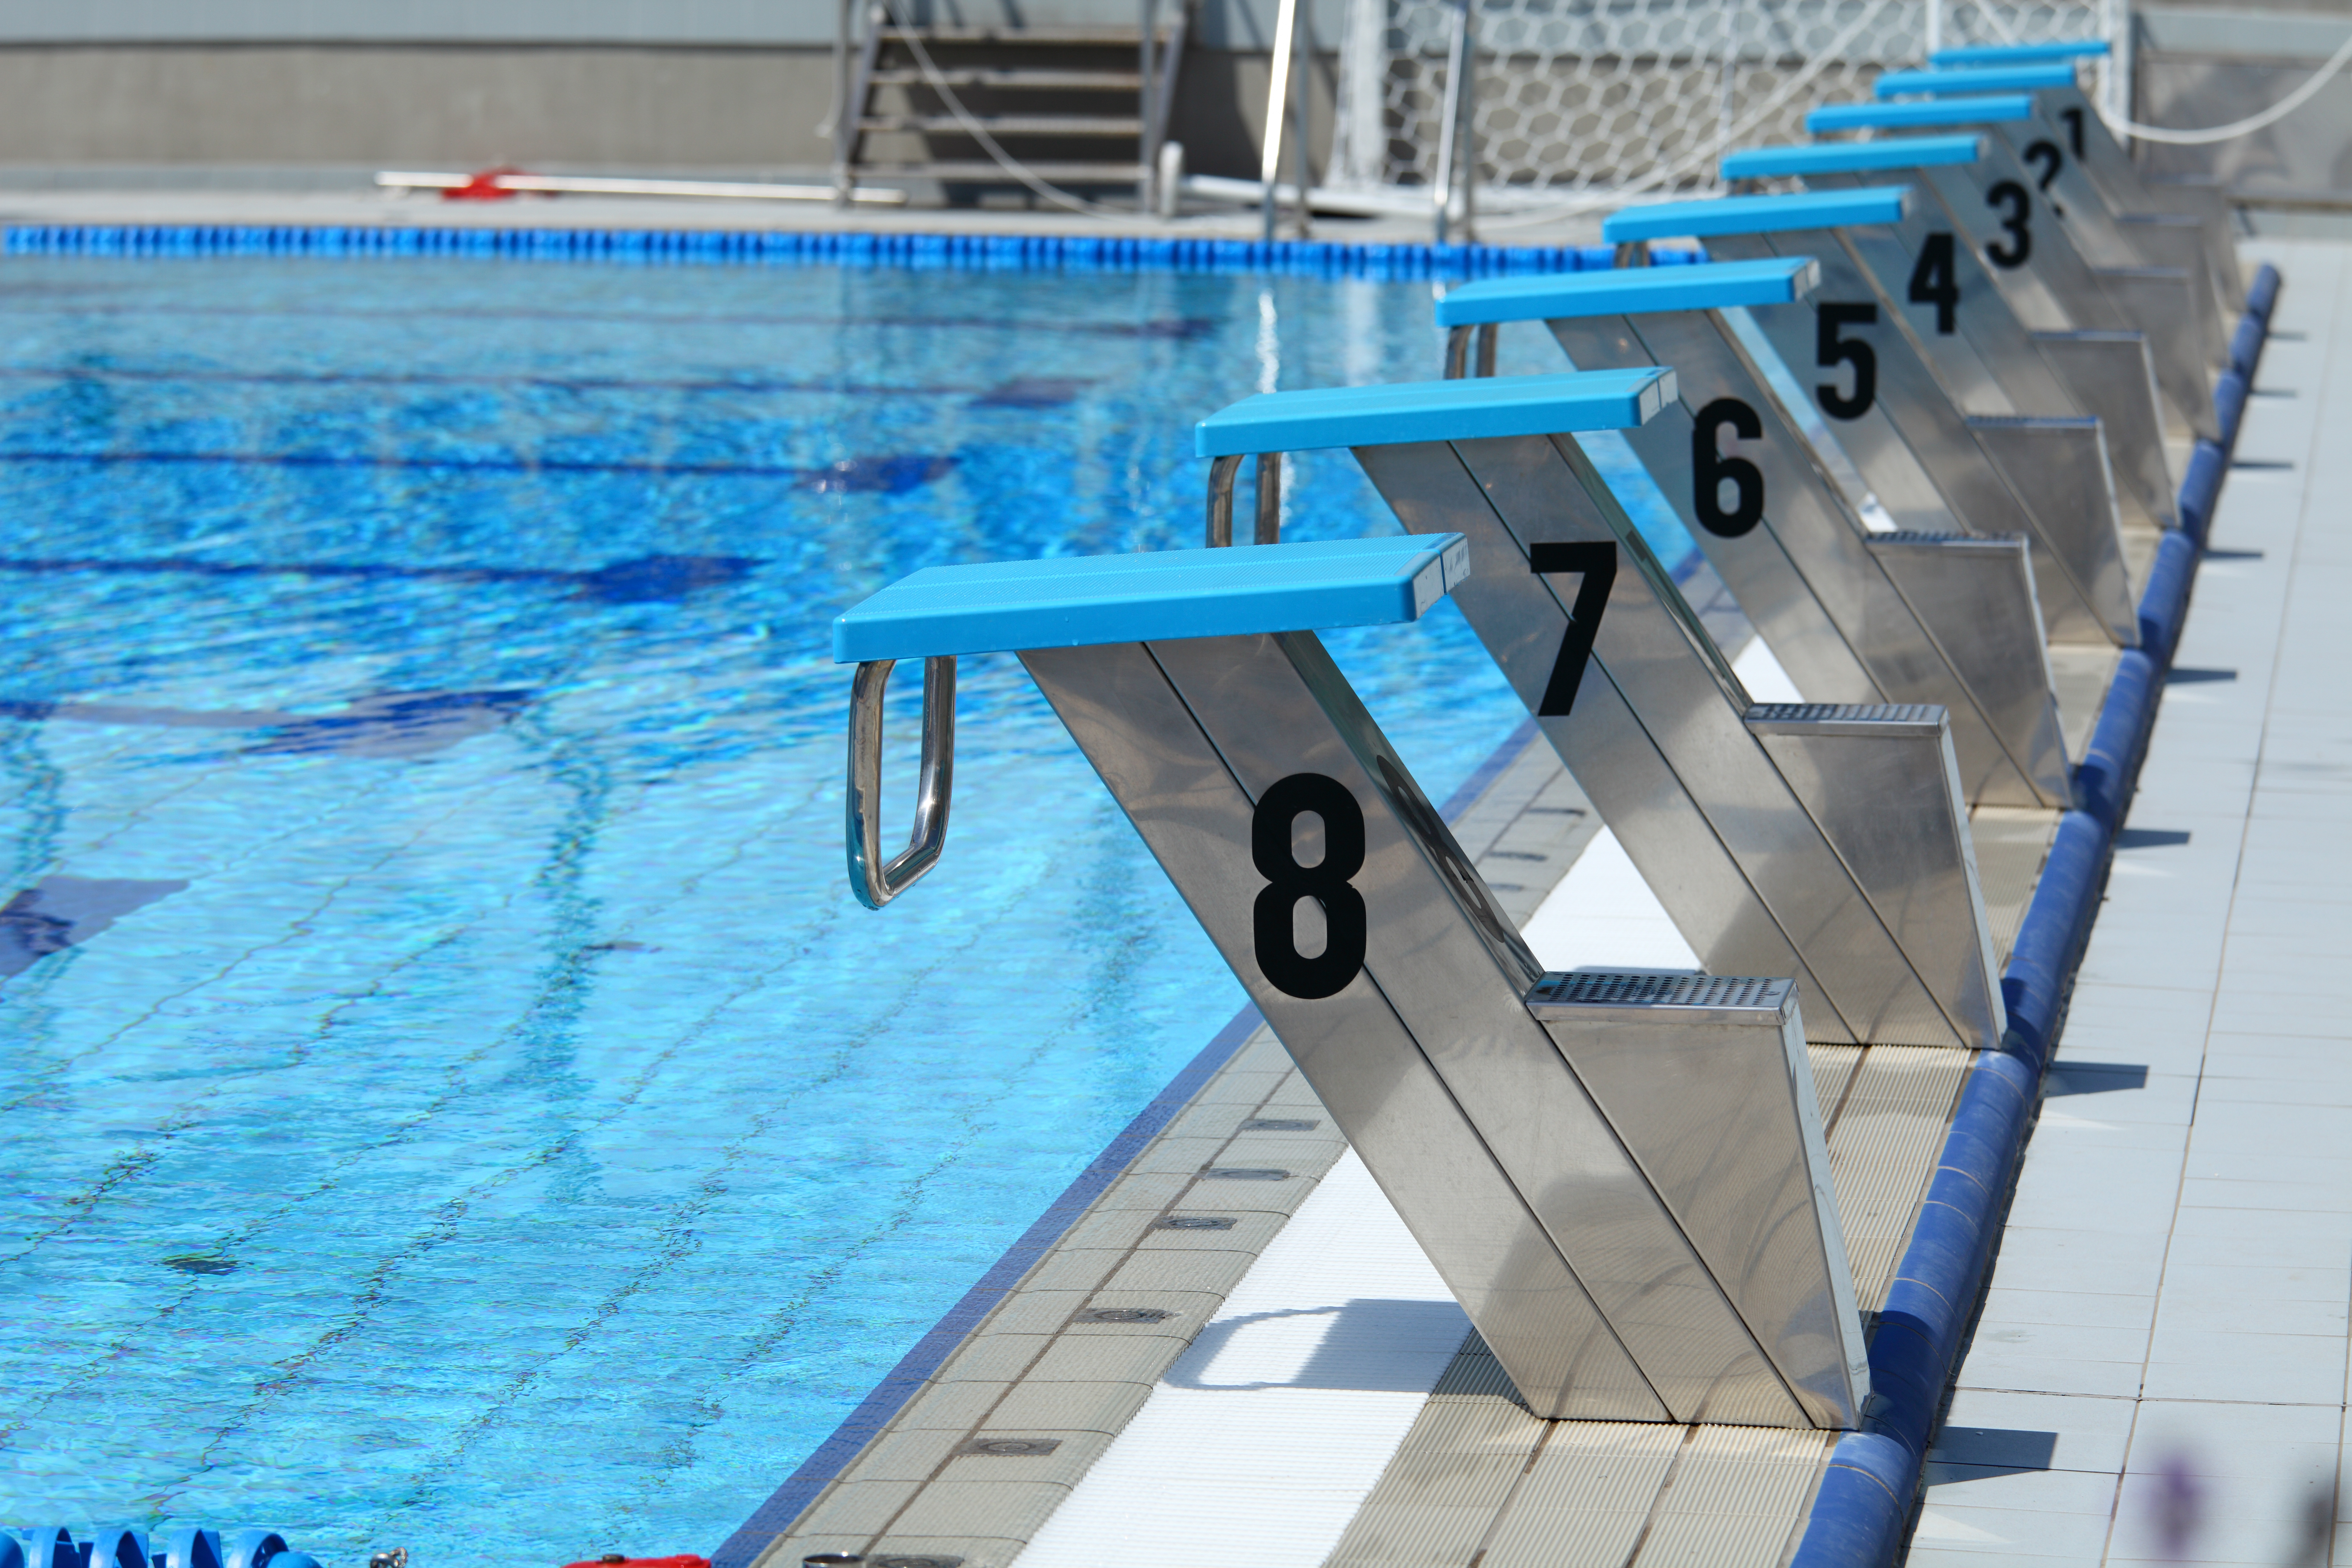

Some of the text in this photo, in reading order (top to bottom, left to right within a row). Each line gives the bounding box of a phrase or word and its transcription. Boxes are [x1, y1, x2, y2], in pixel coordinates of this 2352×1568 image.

[2061, 107, 2084, 161] 1
[1986, 179, 2031, 269] 3
[1908, 232, 1961, 335] 4
[1816, 302, 1878, 420] 5
[1692, 397, 1764, 538] 6
[1530, 541, 1617, 716] 7
[1251, 773, 1367, 1000] 8
